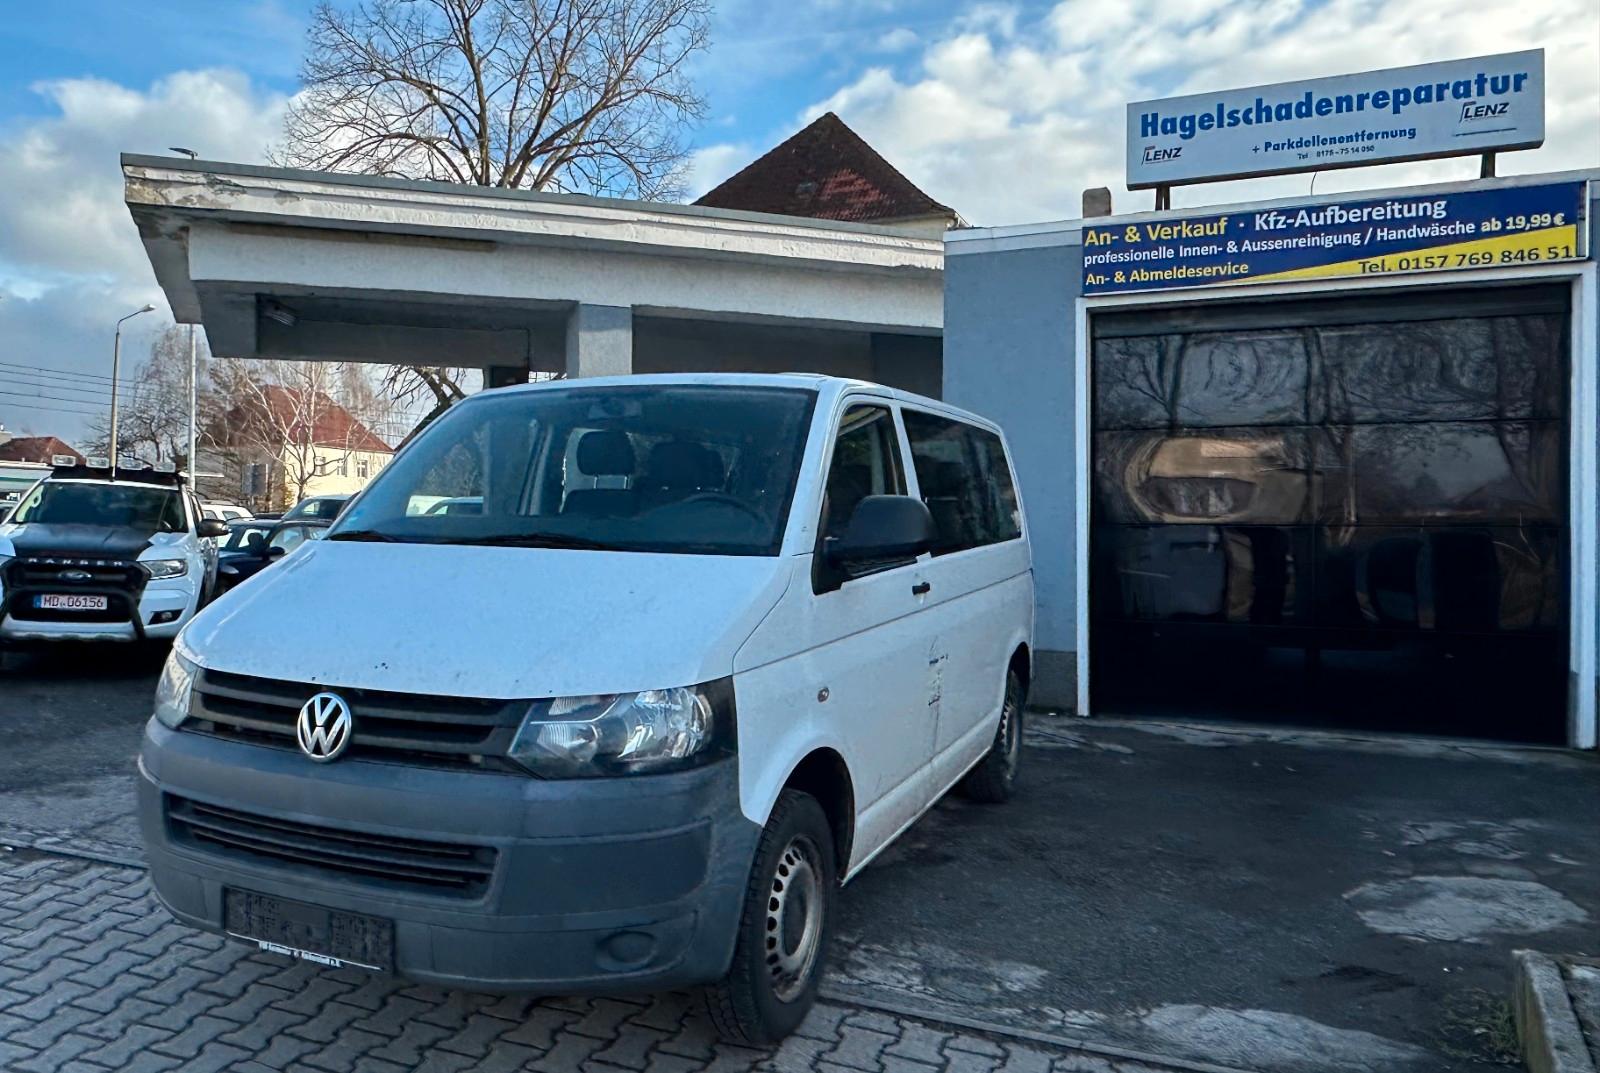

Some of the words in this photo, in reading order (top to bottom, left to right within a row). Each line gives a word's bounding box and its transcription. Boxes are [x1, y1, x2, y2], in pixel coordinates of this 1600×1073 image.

[1141, 73, 1528, 140] Hagelschadenreparatur
[1463, 102, 1510, 119] LENZ
[1144, 147, 1183, 162] LENZ
[1084, 230, 1119, 247] An-
[1124, 226, 1141, 243] &
[1147, 217, 1229, 241] Verkauf
[1255, 200, 1447, 231] Kfz-Aufbereitung
[1084, 246, 1175, 268] professionelle
[1179, 244, 1223, 257] Innen-
[1226, 240, 1239, 254] &
[1241, 232, 1362, 252] Aussenreinigung
[1376, 221, 1476, 241] Handwäsche
[1481, 217, 1502, 232] ab
[1358, 260, 1392, 274] Tel.
[1399, 255, 1449, 271] 0157
[1455, 252, 1493, 267] 769
[1500, 248, 1540, 264] 846
[1547, 245, 1573, 260] 51
[1085, 273, 1110, 286] An-
[1114, 270, 1126, 284] &
[1129, 262, 1249, 282] Abmeldeservice
[43, 595, 60, 607] MD
